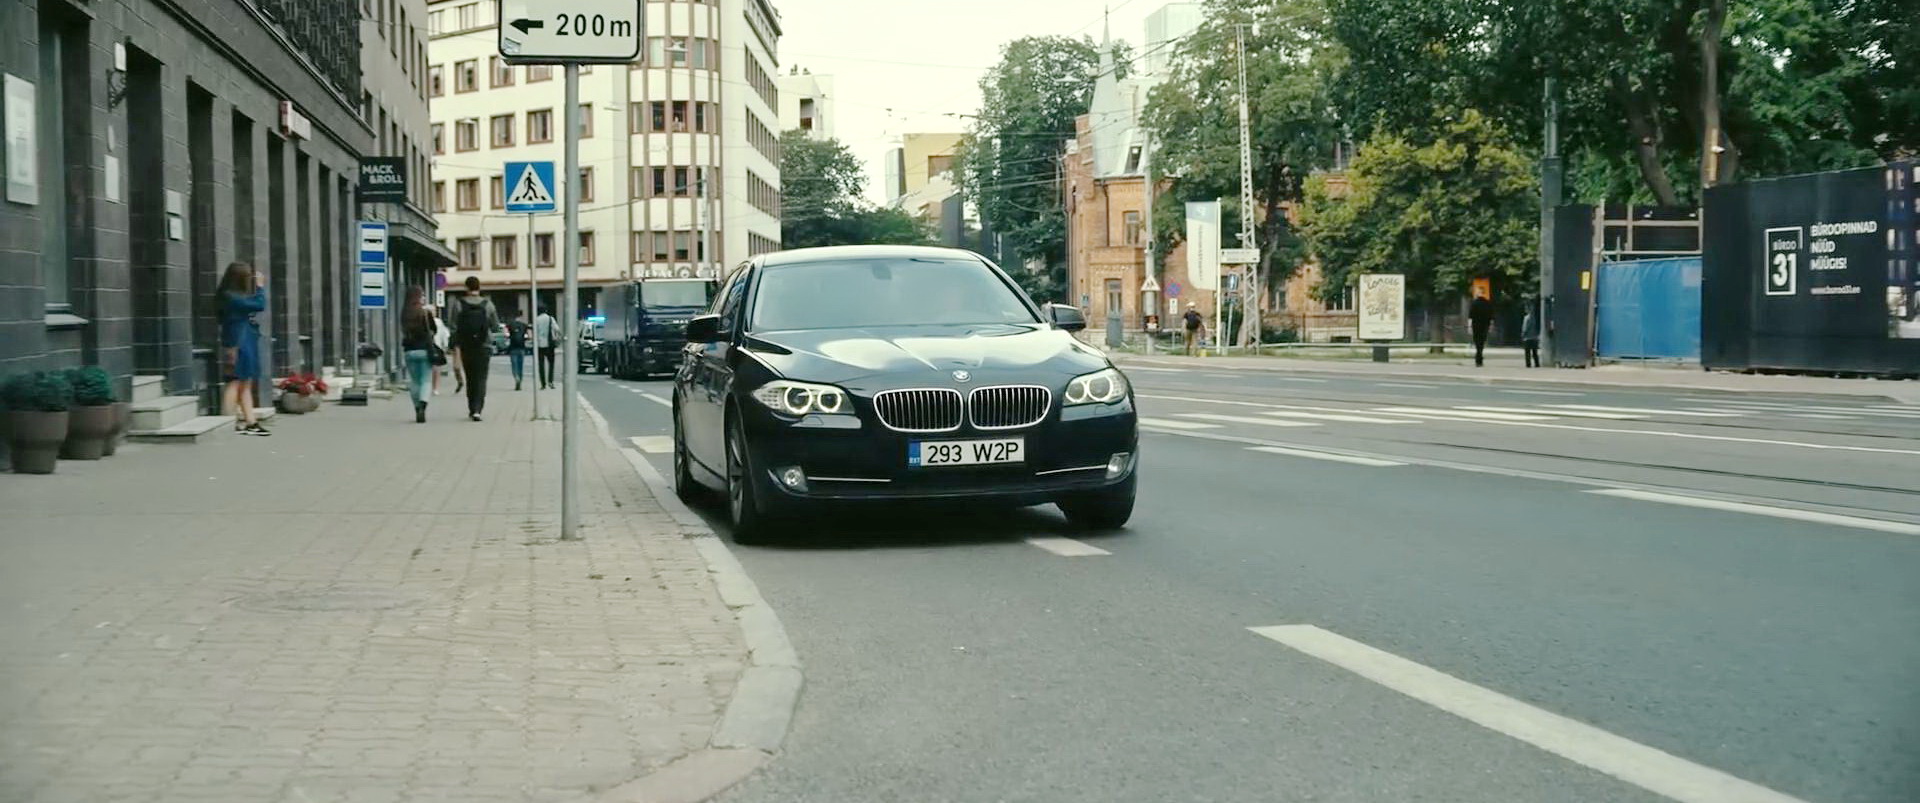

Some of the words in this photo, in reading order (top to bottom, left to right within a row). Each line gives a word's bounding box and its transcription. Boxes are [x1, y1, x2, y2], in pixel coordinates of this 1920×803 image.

[1810, 221, 1877, 237] BÜROOPINNAD
[1810, 238, 1836, 253] NÜÜD
[1773, 252, 1797, 290] 31
[927, 445, 962, 463] 293
[973, 442, 1019, 462] W2P
